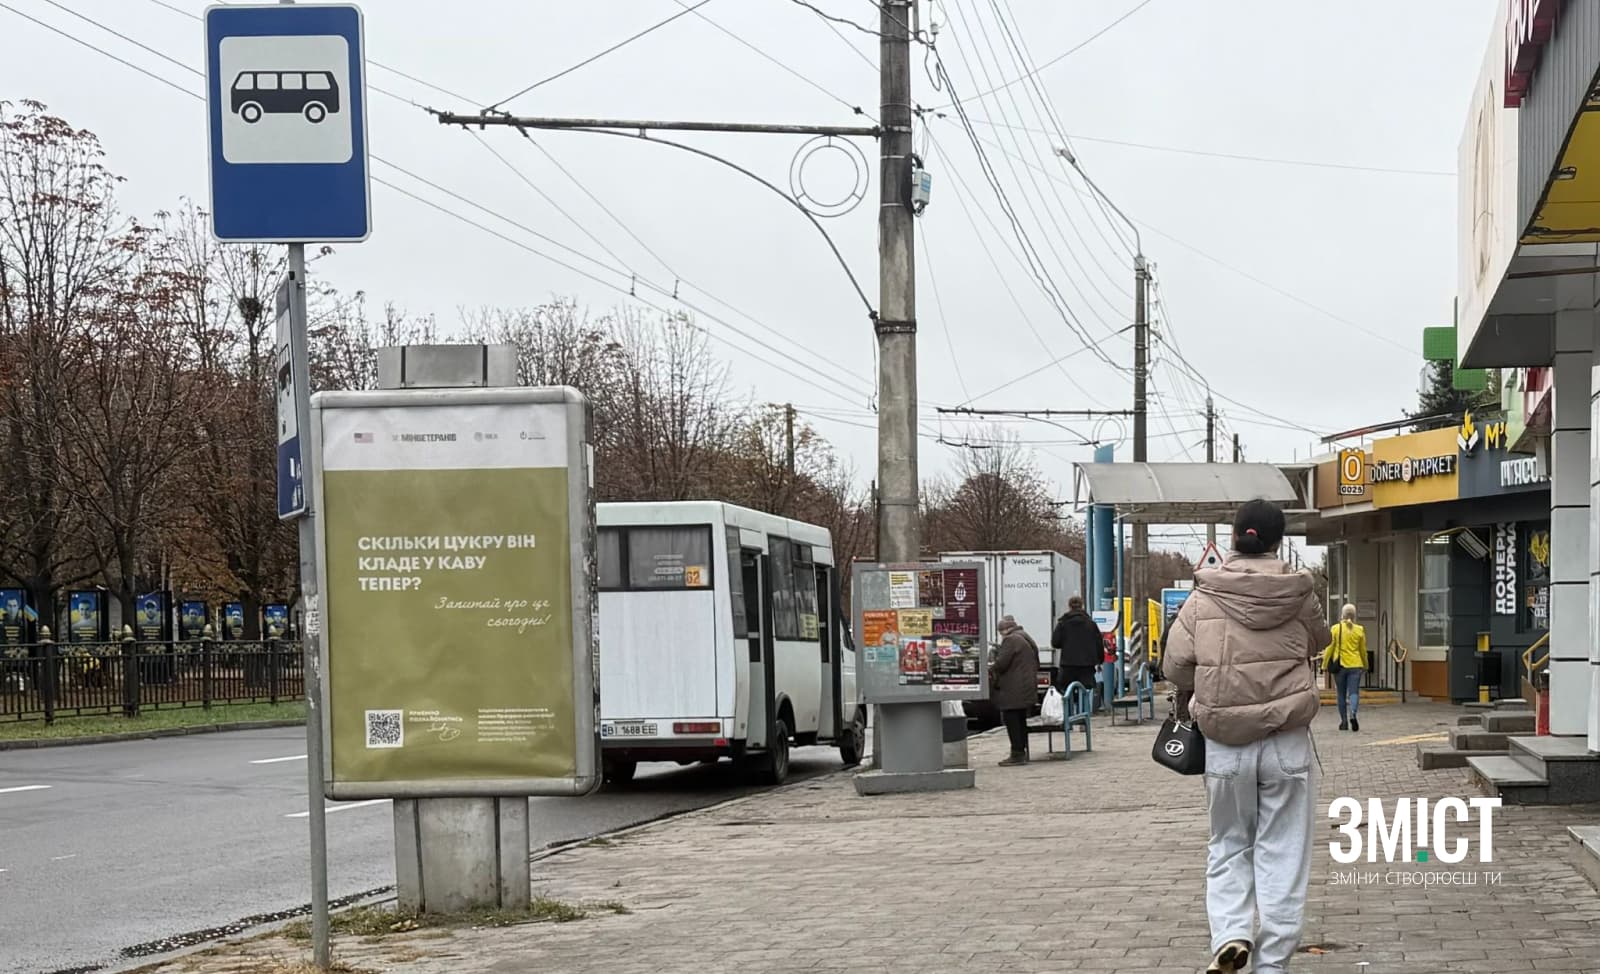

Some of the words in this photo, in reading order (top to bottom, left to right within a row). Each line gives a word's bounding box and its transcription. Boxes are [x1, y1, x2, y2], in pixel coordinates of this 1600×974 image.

[358, 536, 440, 550] СКІЛЬКИ
[444, 535, 504, 551] ЦУКРУ
[507, 534, 536, 549] ВІН
[358, 556, 421, 572] КЛАДЕ
[422, 556, 435, 570] У
[438, 555, 487, 570] КАВУ
[1495, 522, 1506, 615] ДОНЕРИ
[1506, 522, 1517, 615] ШАУРМА
[358, 576, 422, 591] ТЕПЕР?
[435, 597, 501, 610] Запитай
[503, 599, 528, 612] про
[532, 599, 551, 611] це
[488, 614, 552, 634] сьогодні!
